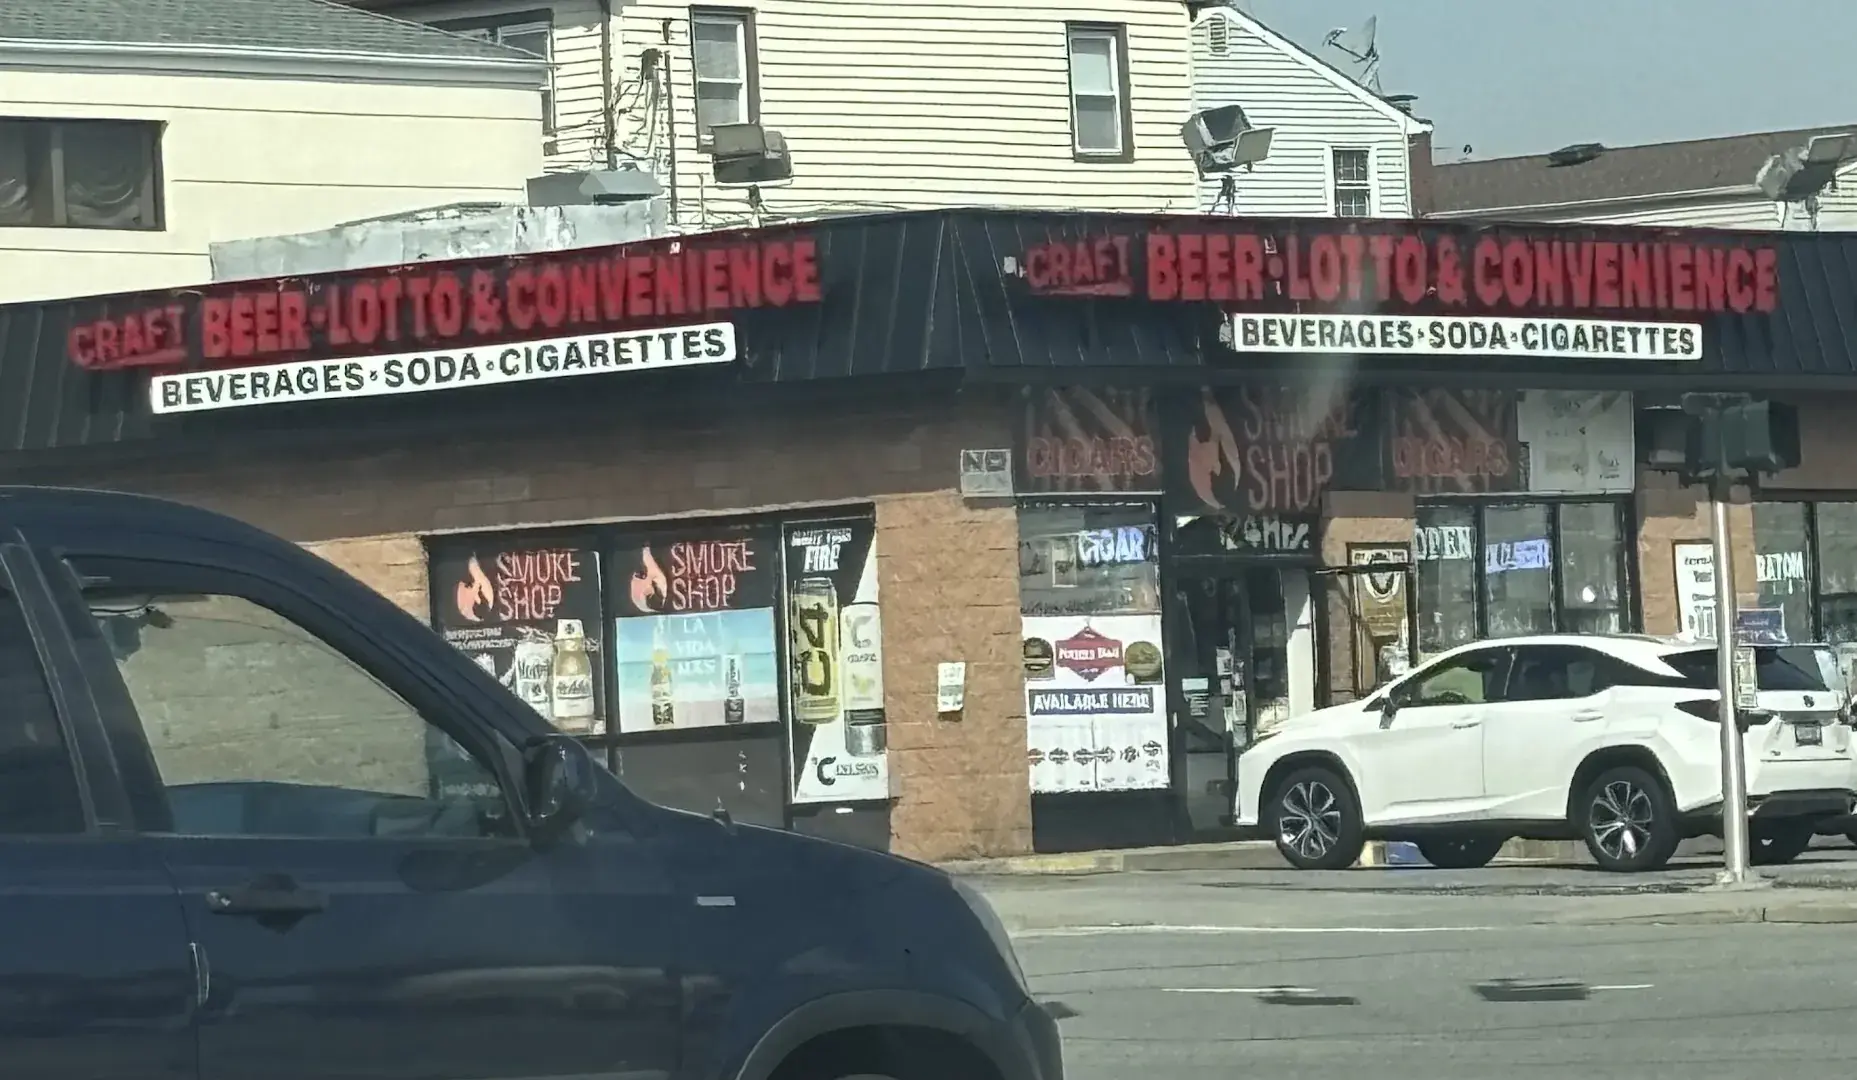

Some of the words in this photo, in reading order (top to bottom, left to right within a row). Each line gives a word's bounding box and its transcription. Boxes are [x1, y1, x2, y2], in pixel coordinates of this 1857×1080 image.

[1026, 234, 1133, 294] CRAFT
[1147, 233, 1264, 300] BEER
[1287, 233, 1427, 304] LOTTO
[1437, 233, 1467, 306] &
[1474, 234, 1777, 313] CONVENIENCE
[69, 304, 187, 369] CRAFT
[203, 296, 310, 359] BEER
[329, 270, 463, 345] LOTTO
[471, 268, 500, 333] &
[506, 240, 821, 331] CONVENIENCE
[1241, 318, 1418, 349] BEVERAGES
[1429, 320, 1510, 350] SODA
[1520, 322, 1695, 356] CIGARETTES
[161, 361, 365, 408] BEVERAGES
[383, 350, 481, 389] SODA
[499, 328, 727, 376] CIGARETTES
[1247, 443, 1334, 511] SHOP
[497, 549, 581, 583] SMOKE
[671, 540, 756, 576] SMOKE
[498, 585, 562, 620] SHOP
[671, 574, 736, 611] SHOP
